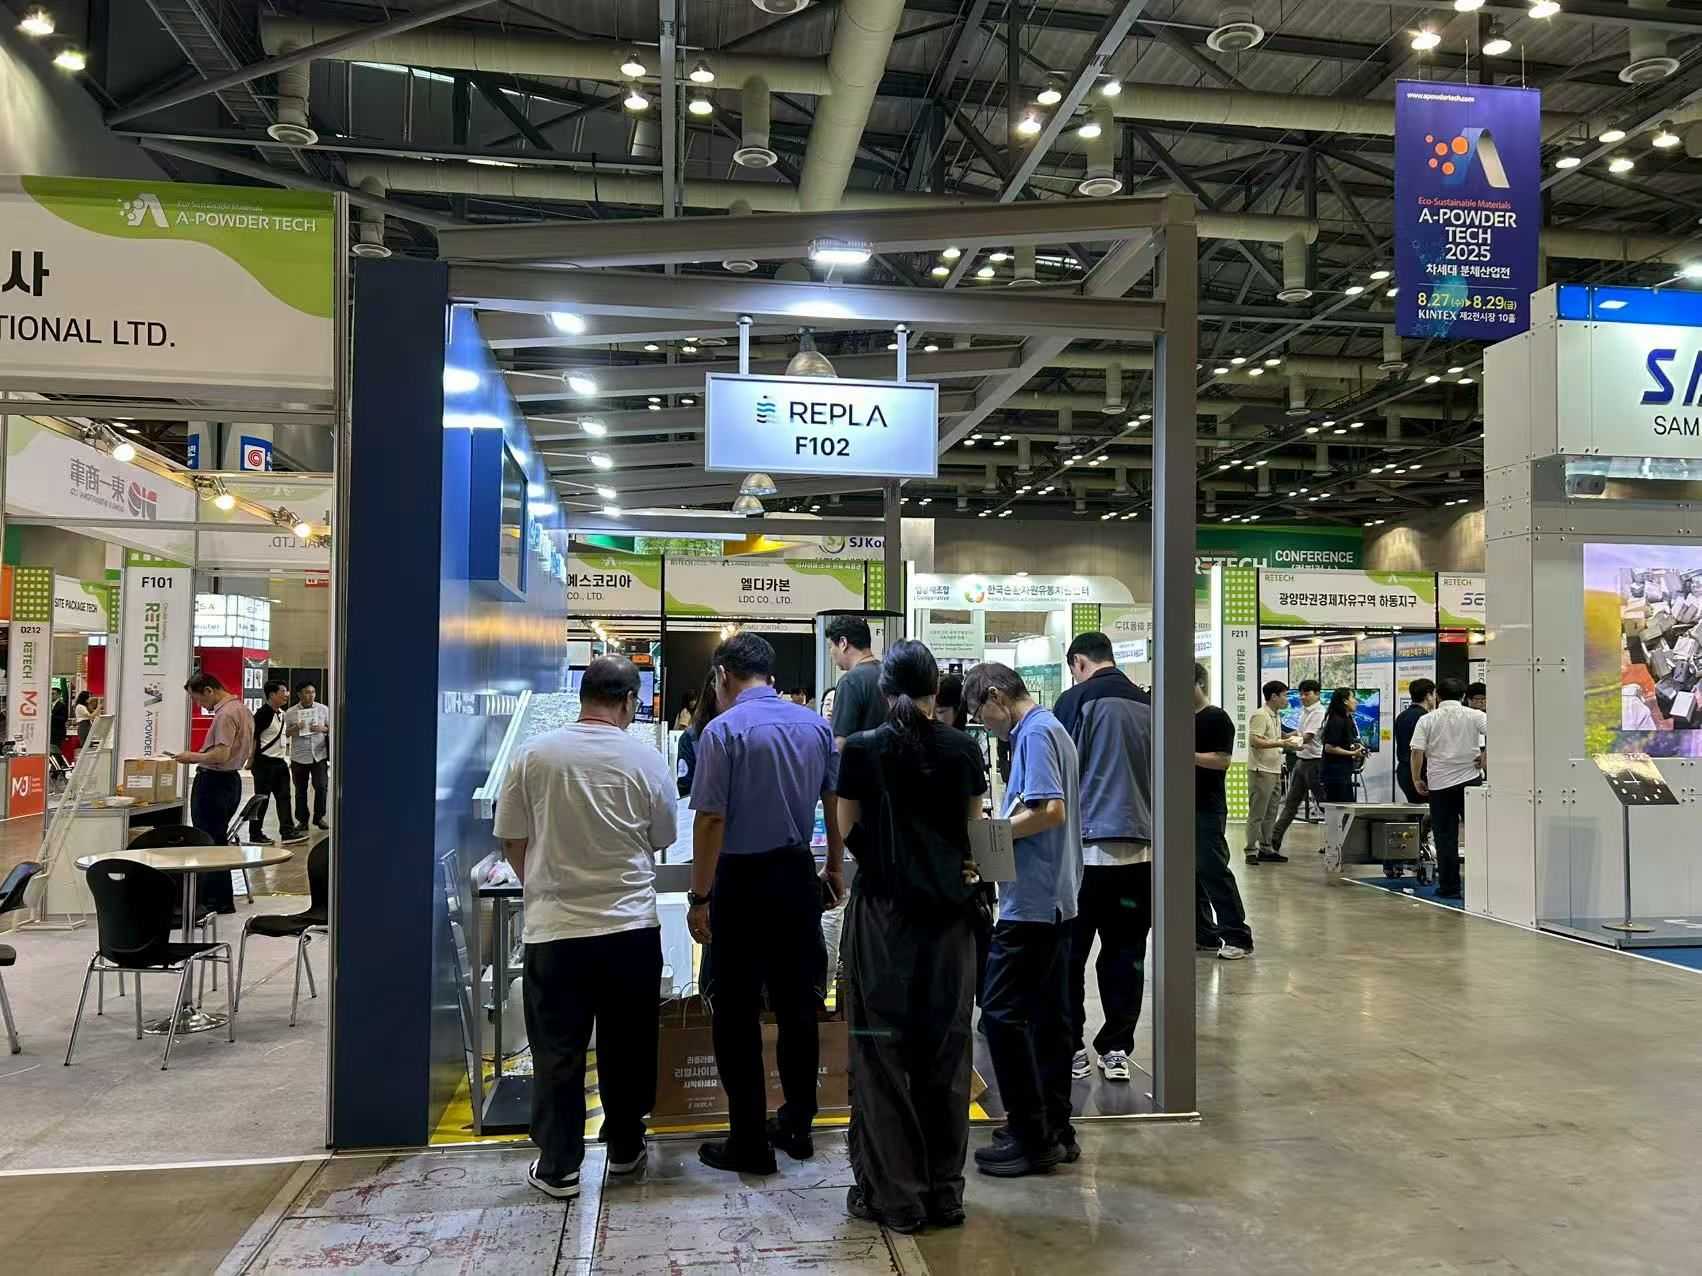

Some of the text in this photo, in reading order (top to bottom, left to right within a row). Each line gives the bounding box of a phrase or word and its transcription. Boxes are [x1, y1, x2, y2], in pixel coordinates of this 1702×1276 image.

[1418, 196, 1511, 209] Eco-Sustainable Materials
[176, 211, 316, 232] A-POWDER TECH
[1418, 207, 1517, 228] A-POWDER
[1445, 226, 1492, 244] TECH
[1445, 244, 1491, 261] 2025
[2, 250, 50, 296] 사
[1426, 263, 1511, 279] 차세대 분체산업전
[1418, 309, 1457, 320] KINTEX
[1459, 312, 1496, 323] 제2전시장
[113, 320, 175, 347] LTD.
[790, 401, 888, 427] REPLA
[1654, 415, 1699, 436] SAM
[796, 436, 850, 456] F102
[1275, 550, 1354, 563] CONFERENCE
[141, 577, 173, 589] F101
[741, 578, 791, 592] 엘디카본
[1279, 592, 1417, 608] 광양만권경제자유구역 하동지구
[144, 603, 161, 666] RETECH
[1231, 630, 1248, 638] F211
[22, 641, 32, 679] RETECH
[143, 710, 153, 757] A-POWDER
